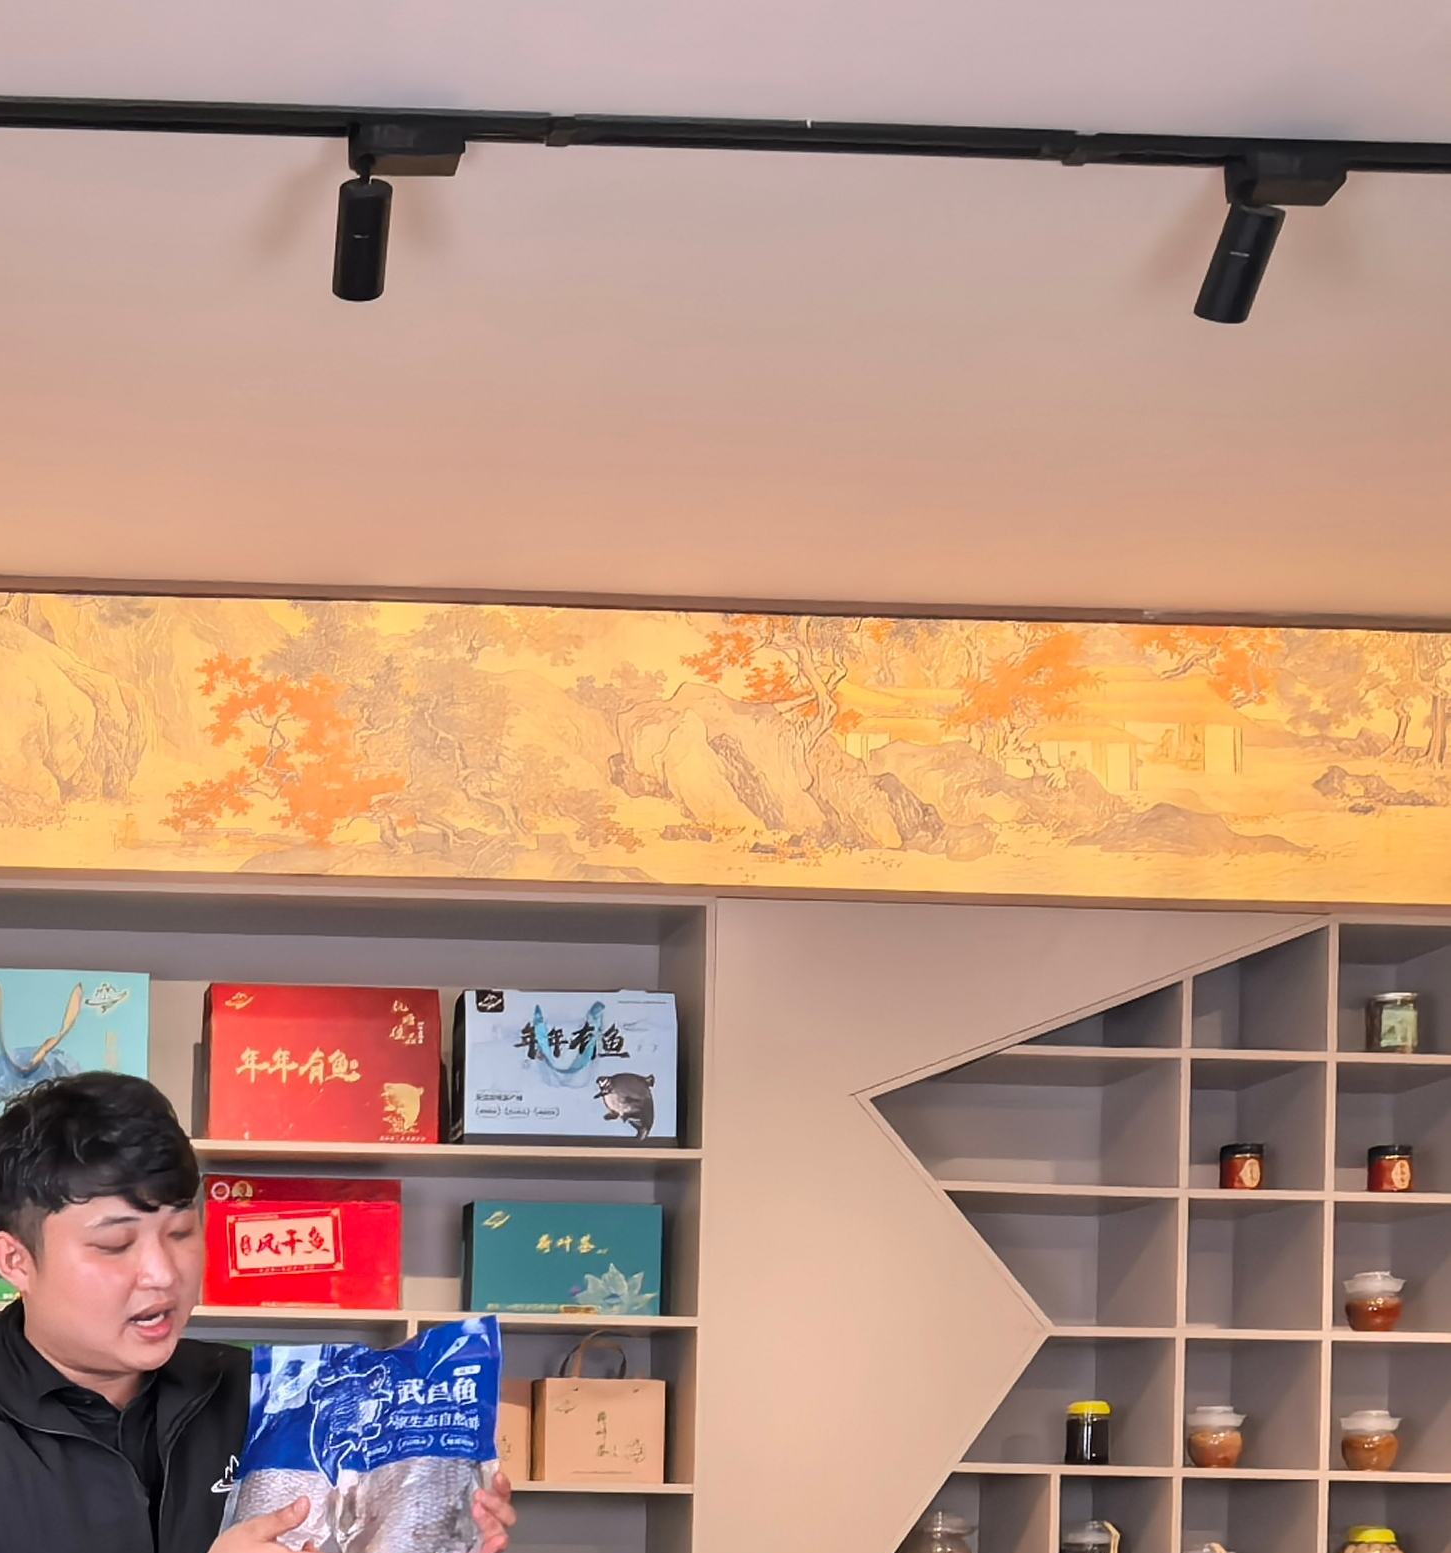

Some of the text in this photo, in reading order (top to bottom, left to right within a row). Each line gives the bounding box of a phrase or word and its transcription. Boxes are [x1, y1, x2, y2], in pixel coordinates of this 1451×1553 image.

[514, 1022, 630, 1060] 年年有鱼
[236, 1047, 361, 1084] 年年有鱼
[256, 1226, 330, 1256] 风干鱼
